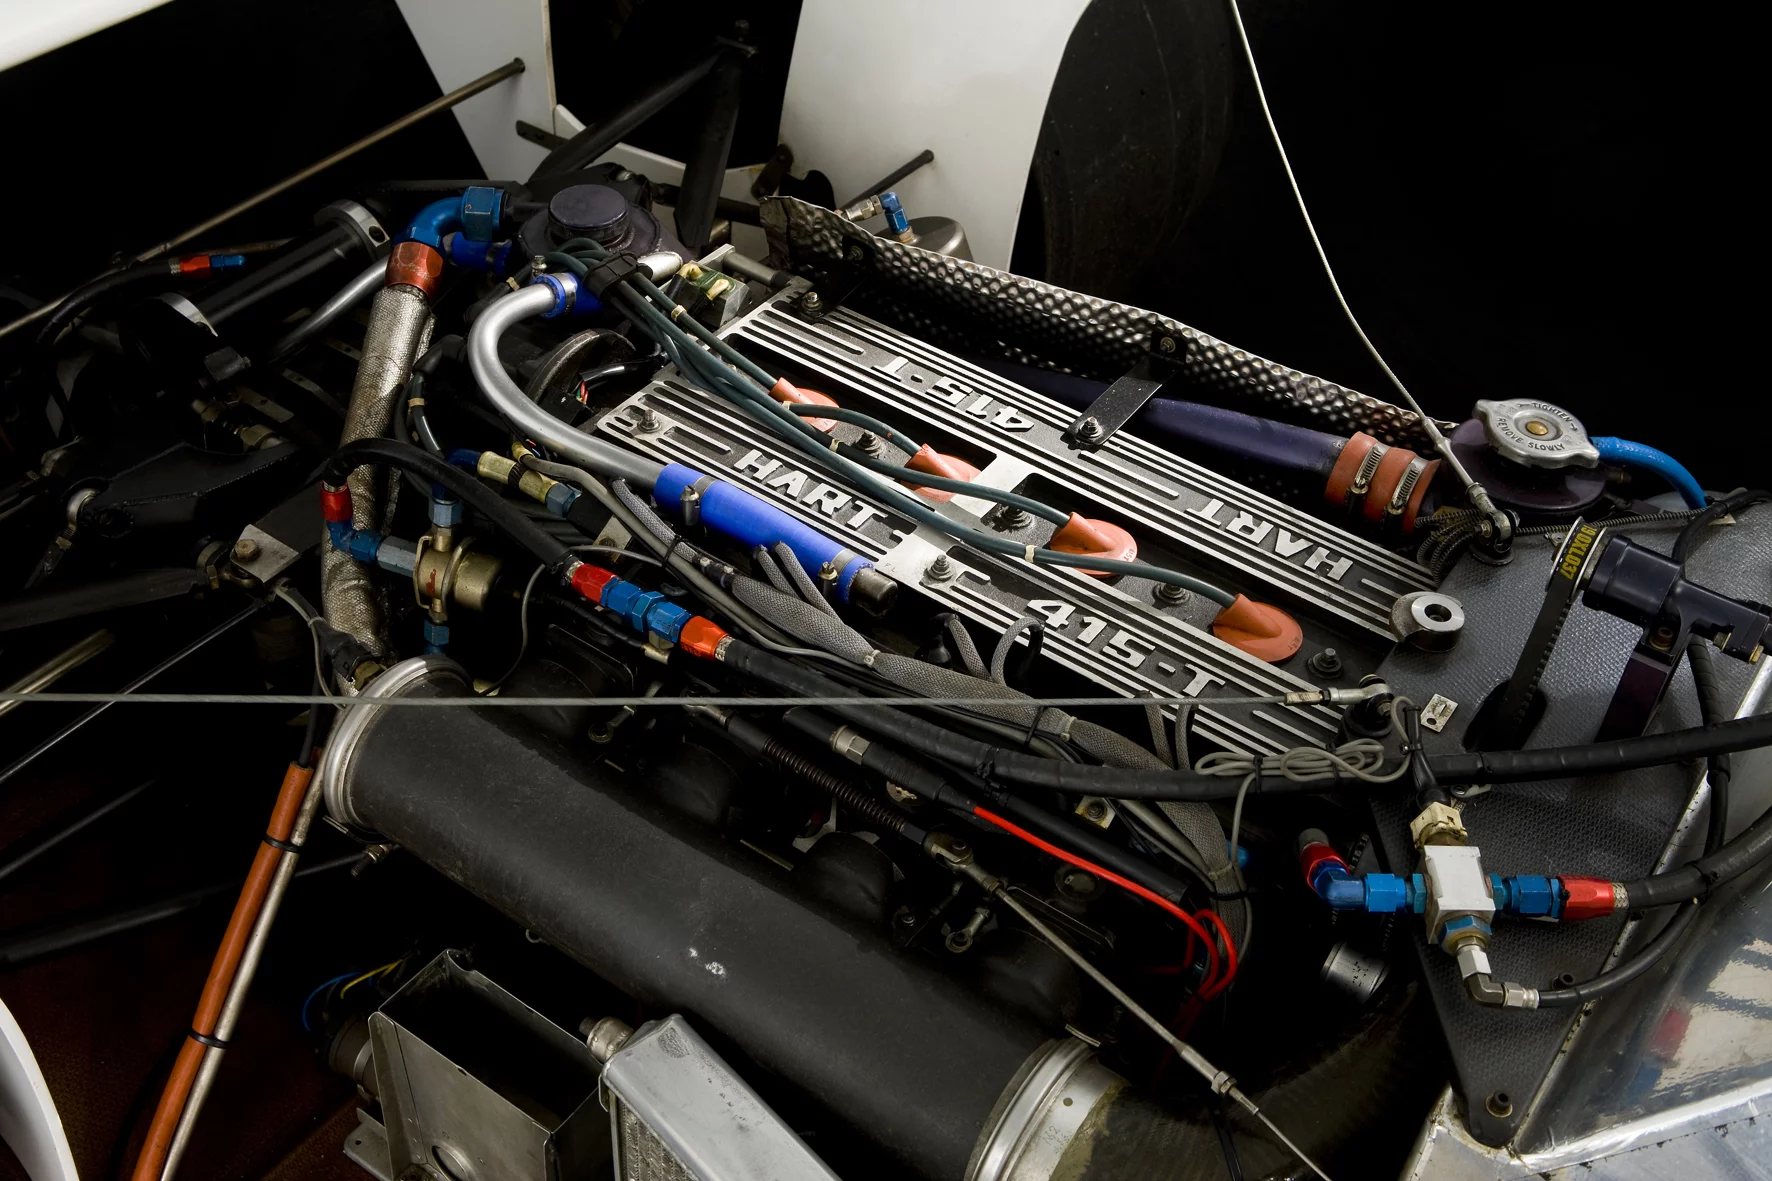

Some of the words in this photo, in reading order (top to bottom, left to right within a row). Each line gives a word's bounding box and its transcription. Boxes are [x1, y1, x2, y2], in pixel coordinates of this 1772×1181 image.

[872, 355, 1035, 431] 415-T
[1532, 402, 1573, 422] TIGHTEN
[1497, 418, 1524, 444] REMOVE
[1527, 441, 1566, 452] SLOWLY
[733, 448, 889, 529] HART
[1026, 599, 1226, 698] 415-T
[1186, 498, 1354, 581] HART
